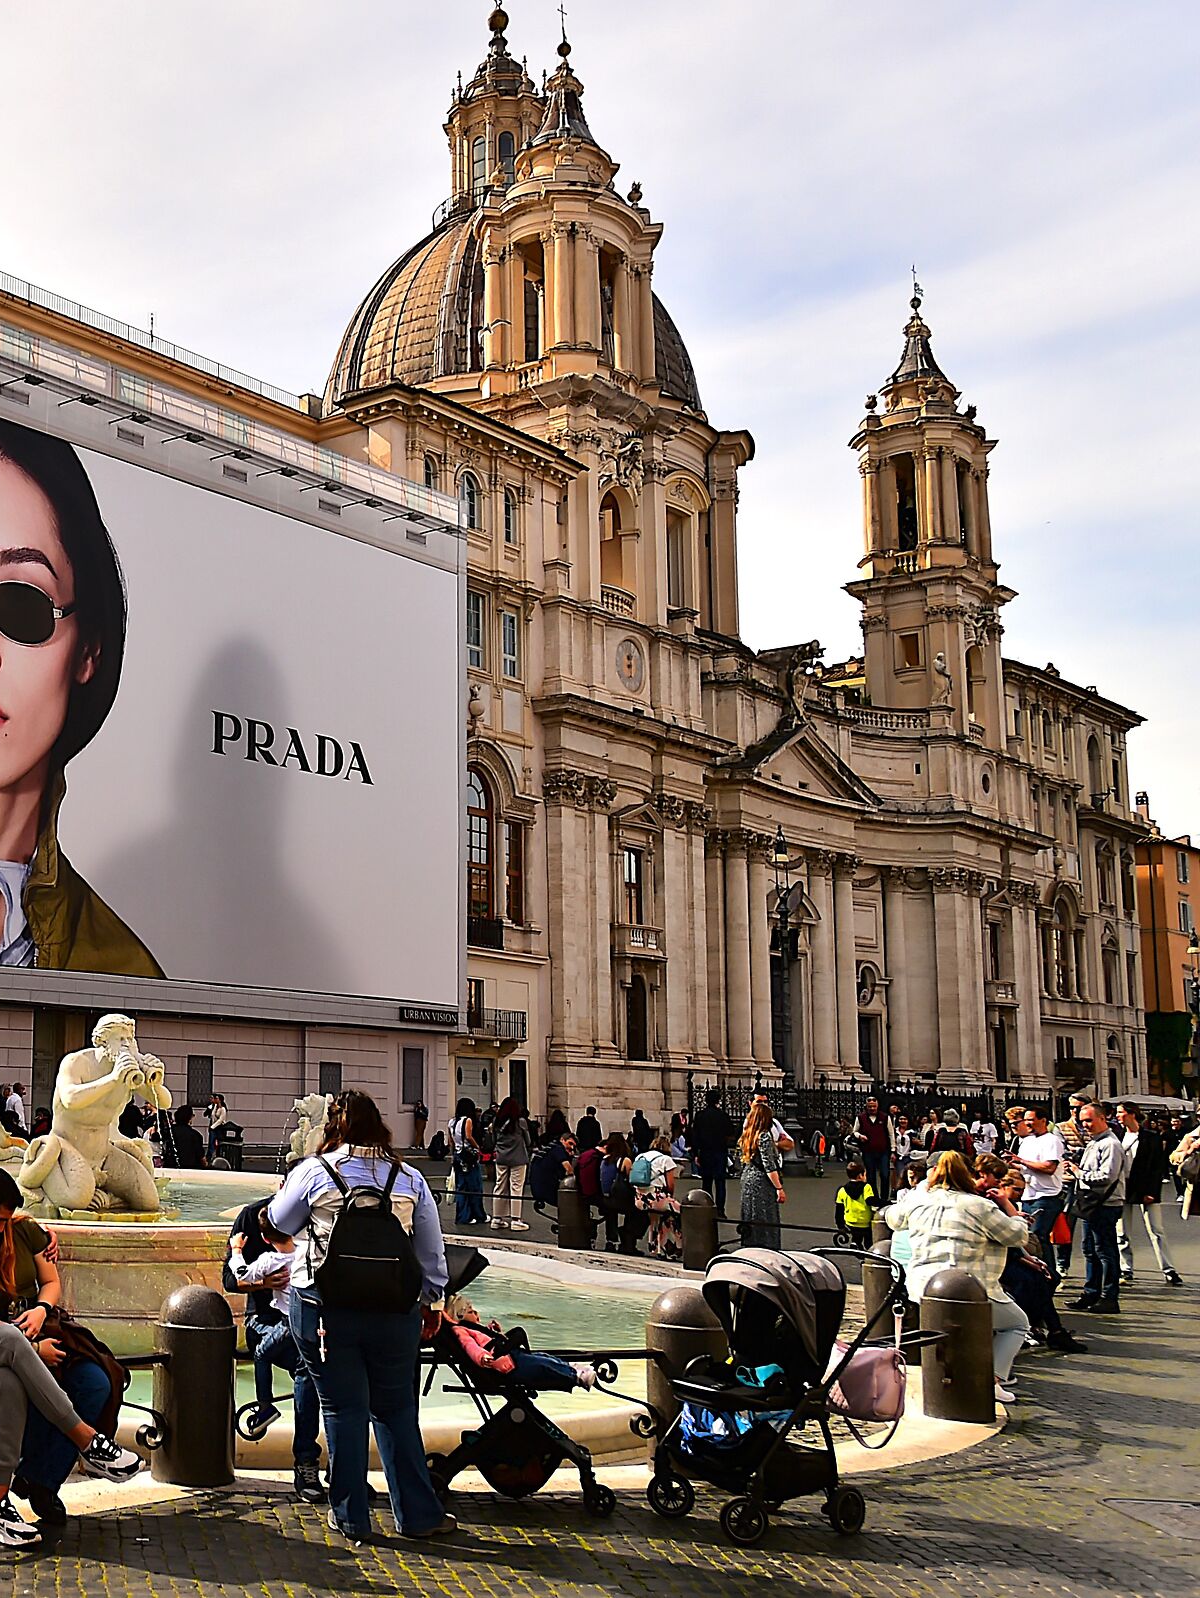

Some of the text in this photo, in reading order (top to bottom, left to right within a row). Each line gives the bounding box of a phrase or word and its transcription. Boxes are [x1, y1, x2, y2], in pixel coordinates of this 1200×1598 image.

[211, 710, 374, 785] PRADA
[404, 1009, 457, 1023] URBAN VISION
